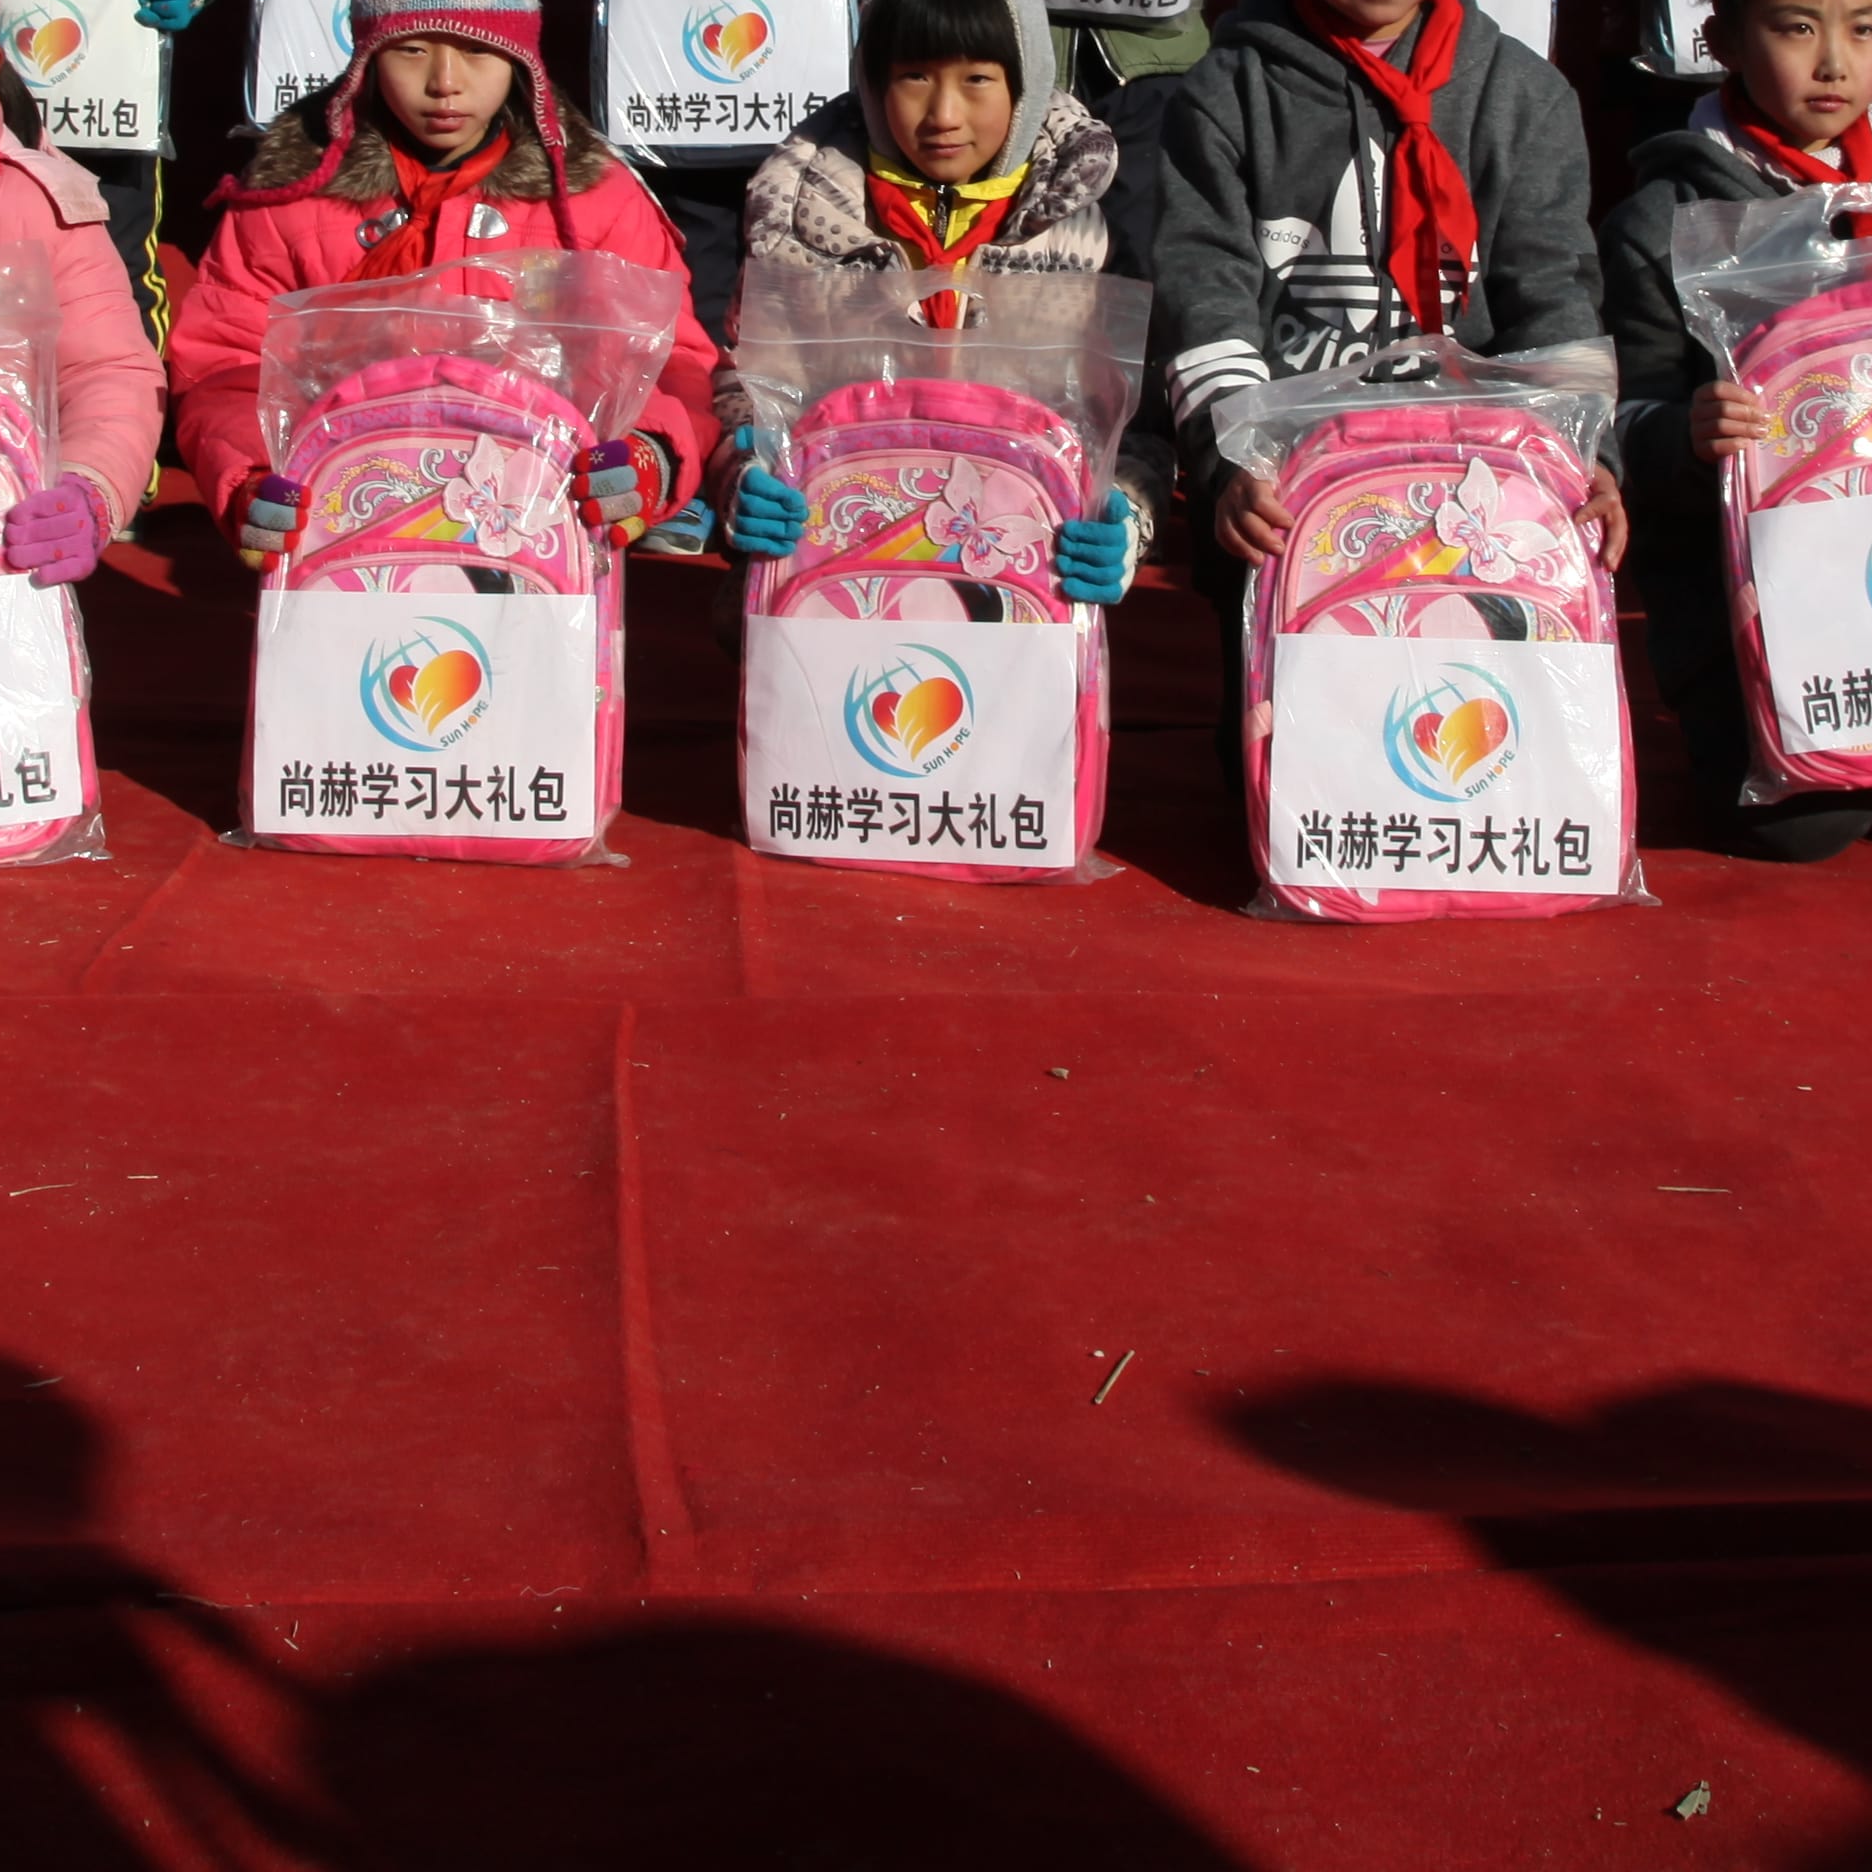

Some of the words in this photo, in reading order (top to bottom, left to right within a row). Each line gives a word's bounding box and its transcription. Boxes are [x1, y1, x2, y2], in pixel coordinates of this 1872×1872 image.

[1259, 227, 1312, 251] adidas
[280, 759, 569, 823] 尚赫学习大礼包
[769, 782, 1049, 851] 尚赫学习大礼包
[1296, 809, 1594, 878] 尚赫学习大礼包
